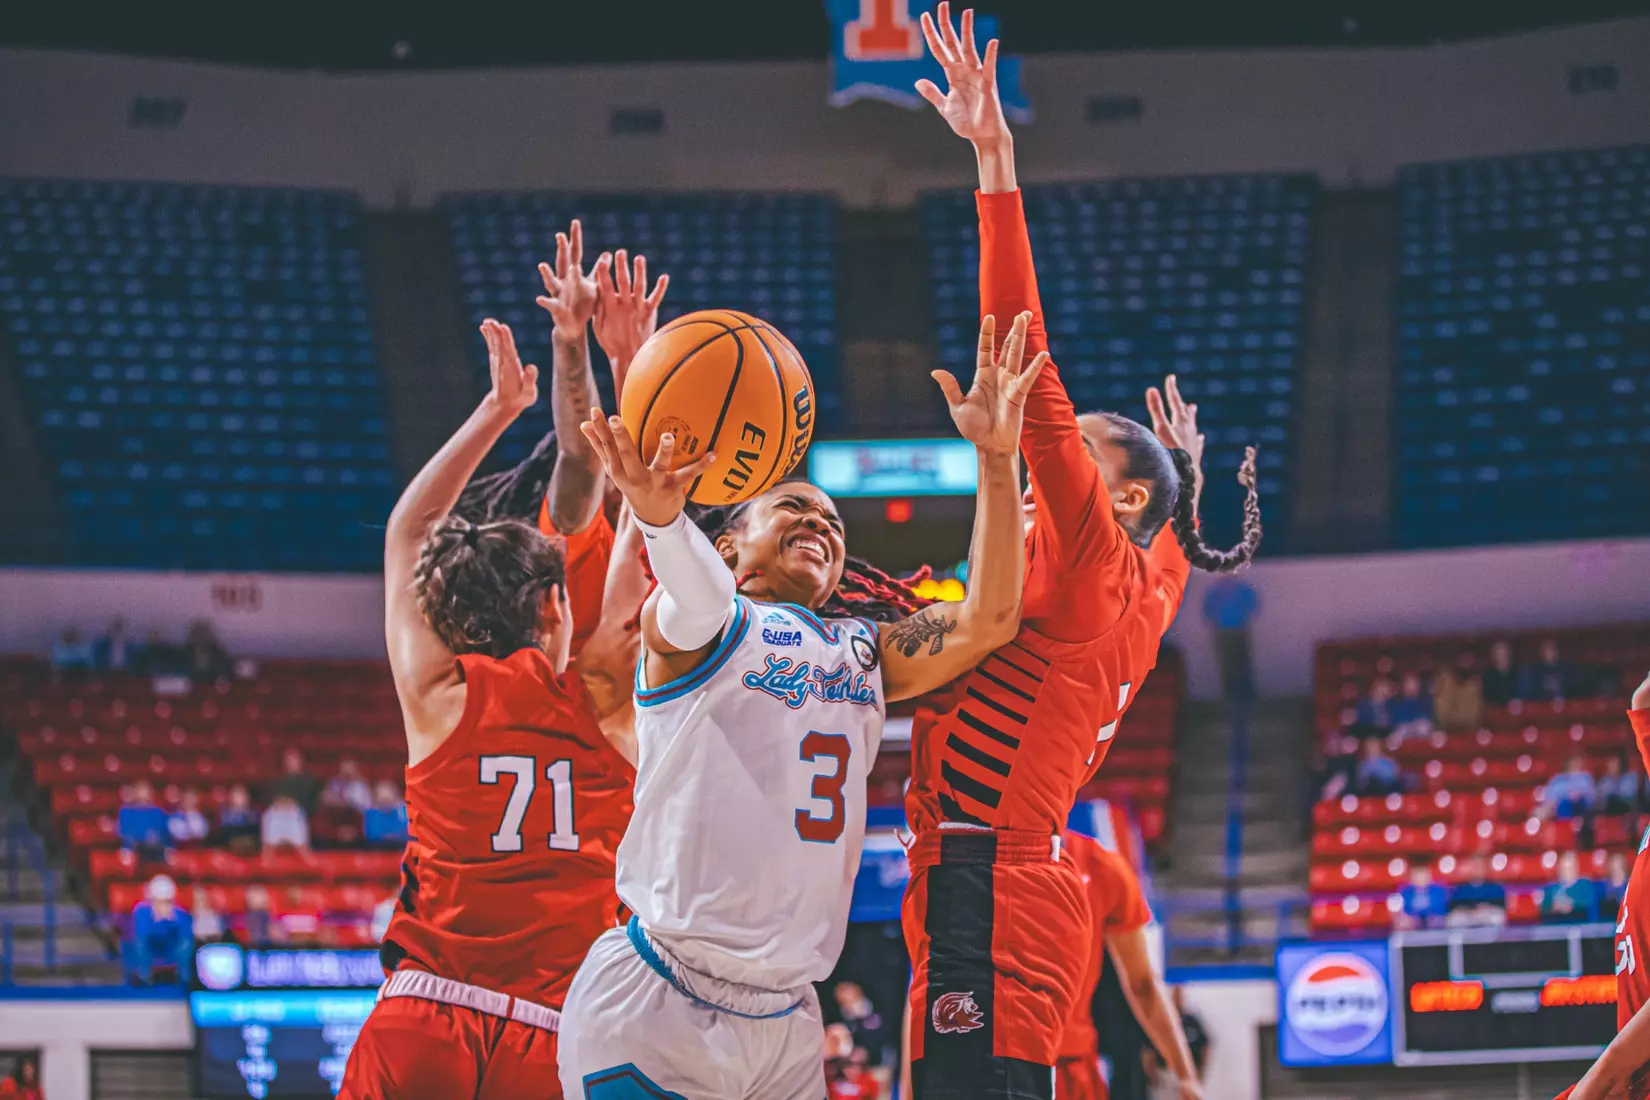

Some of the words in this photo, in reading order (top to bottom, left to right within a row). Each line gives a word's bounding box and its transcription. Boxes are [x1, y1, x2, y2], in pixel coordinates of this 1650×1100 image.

[722, 421, 766, 491] EVO
[742, 652, 811, 710] Lady
[479, 755, 579, 852] 71
[794, 730, 852, 844] 3
